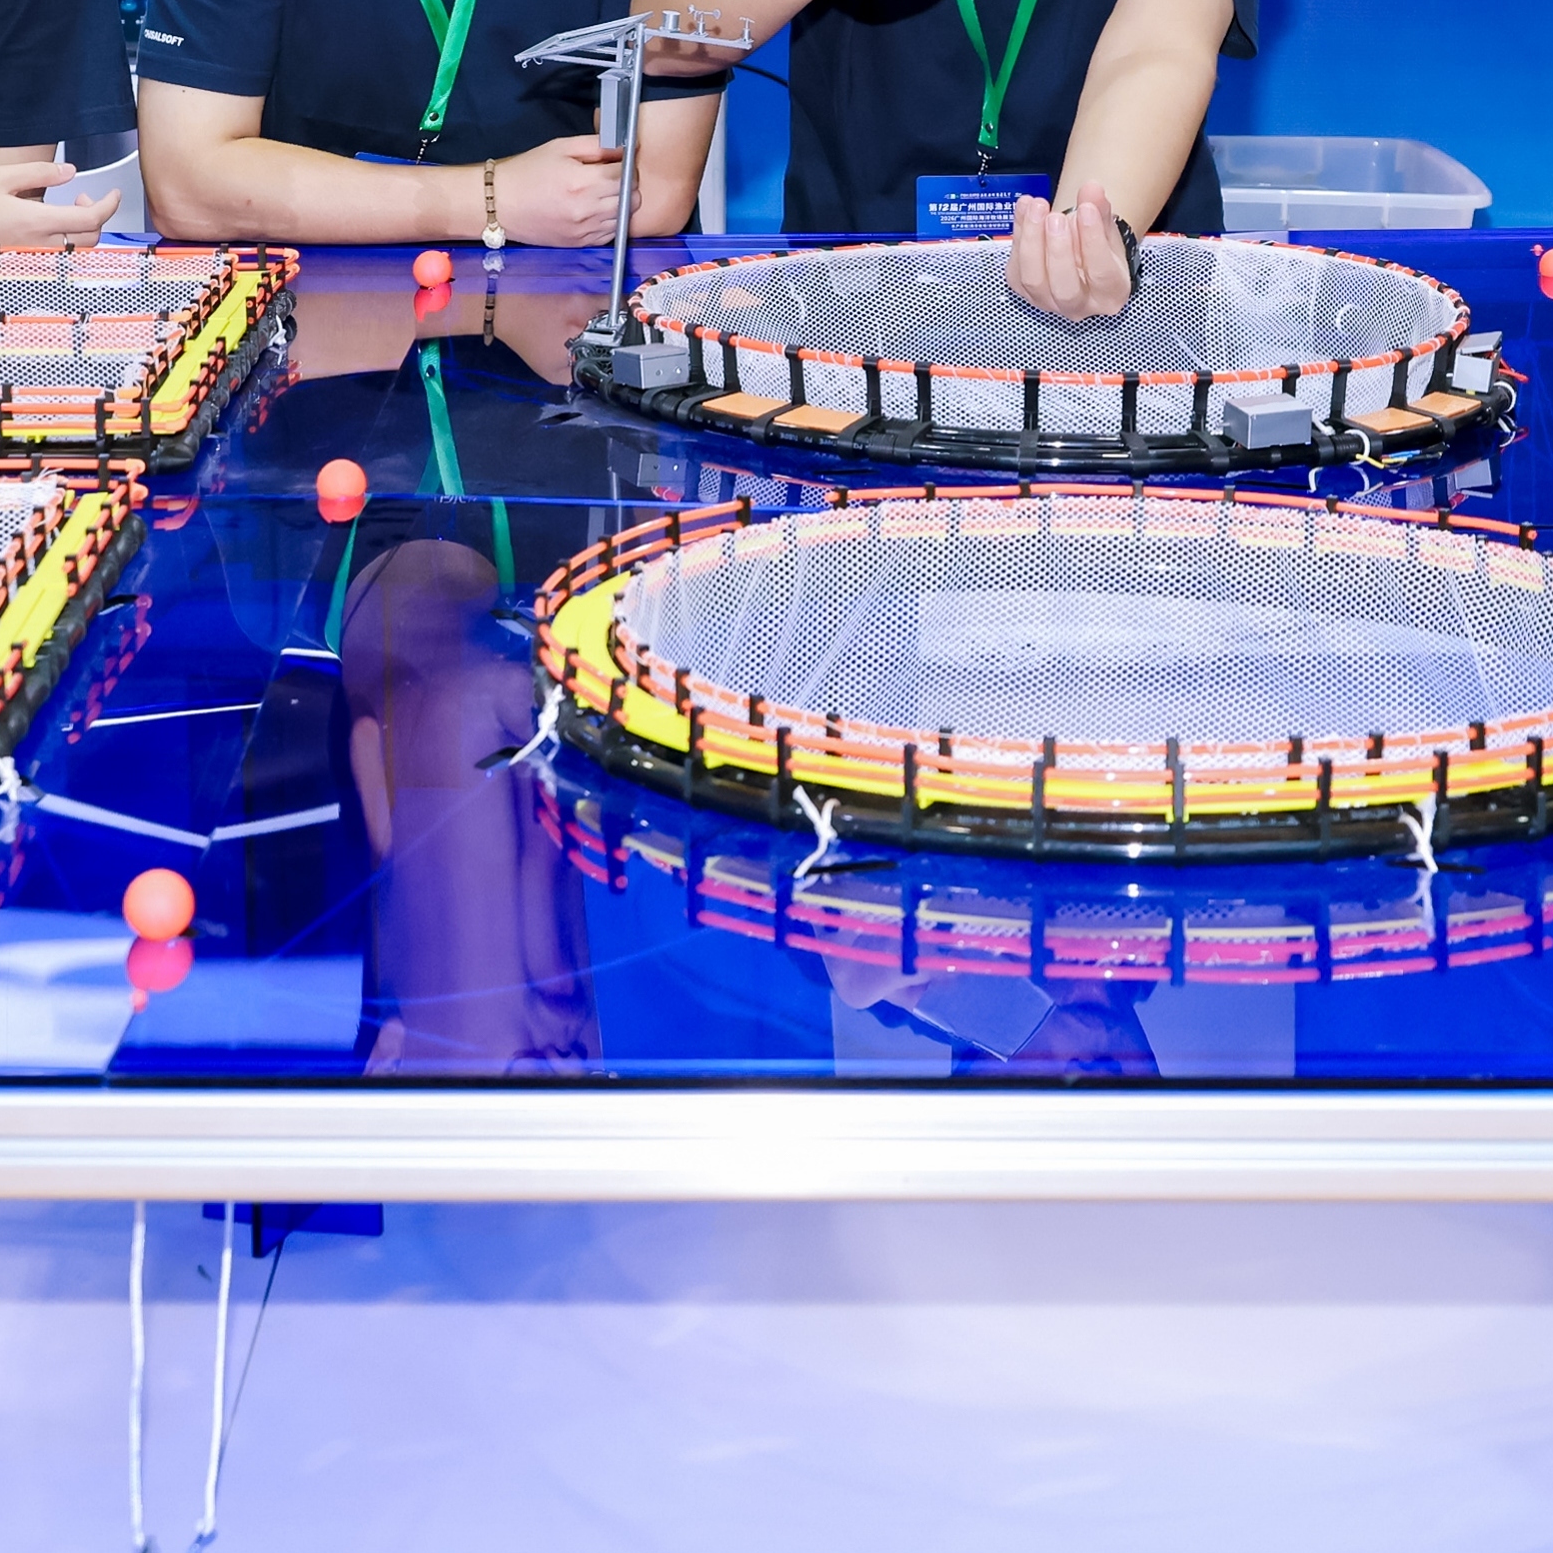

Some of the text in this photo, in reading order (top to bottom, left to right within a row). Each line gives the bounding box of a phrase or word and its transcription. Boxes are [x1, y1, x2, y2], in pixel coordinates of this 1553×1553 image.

[928, 202, 1016, 212] 第12届广州国际渔业
